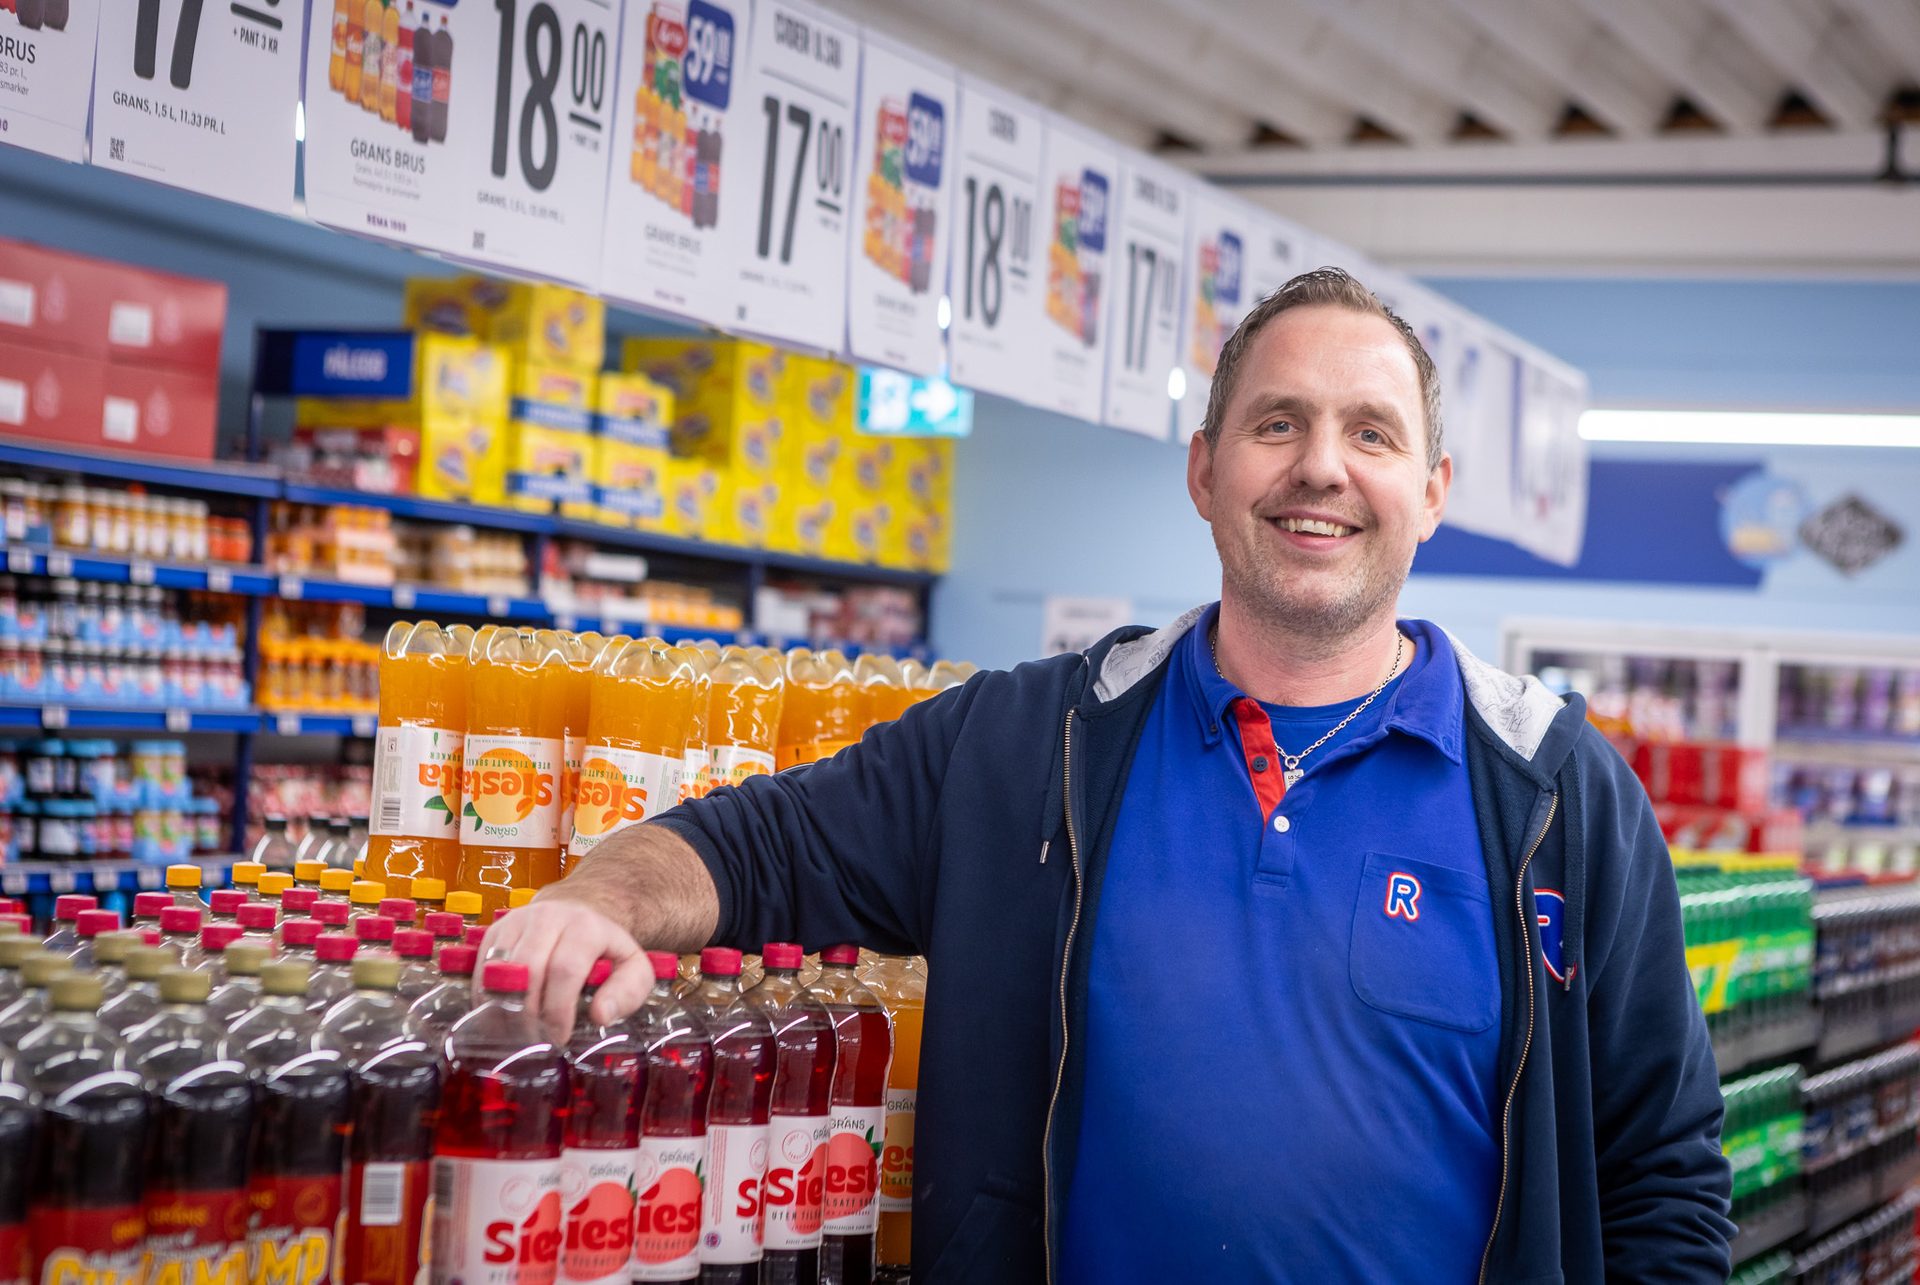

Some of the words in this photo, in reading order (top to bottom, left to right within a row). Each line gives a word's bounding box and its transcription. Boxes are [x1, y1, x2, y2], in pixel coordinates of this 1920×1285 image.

[240, 27, 260, 48] PANT
[261, 36, 267, 50] 3
[268, 39, 279, 54] KR
[572, 21, 606, 112] 00
[112, 91, 152, 115] GRANS,
[491, 0, 562, 192] 18
[350, 137, 391, 166] GRANS
[394, 150, 425, 175] BRUS
[757, 95, 812, 266] 17
[963, 175, 1005, 330] 18
[1384, 871, 1422, 922] R
